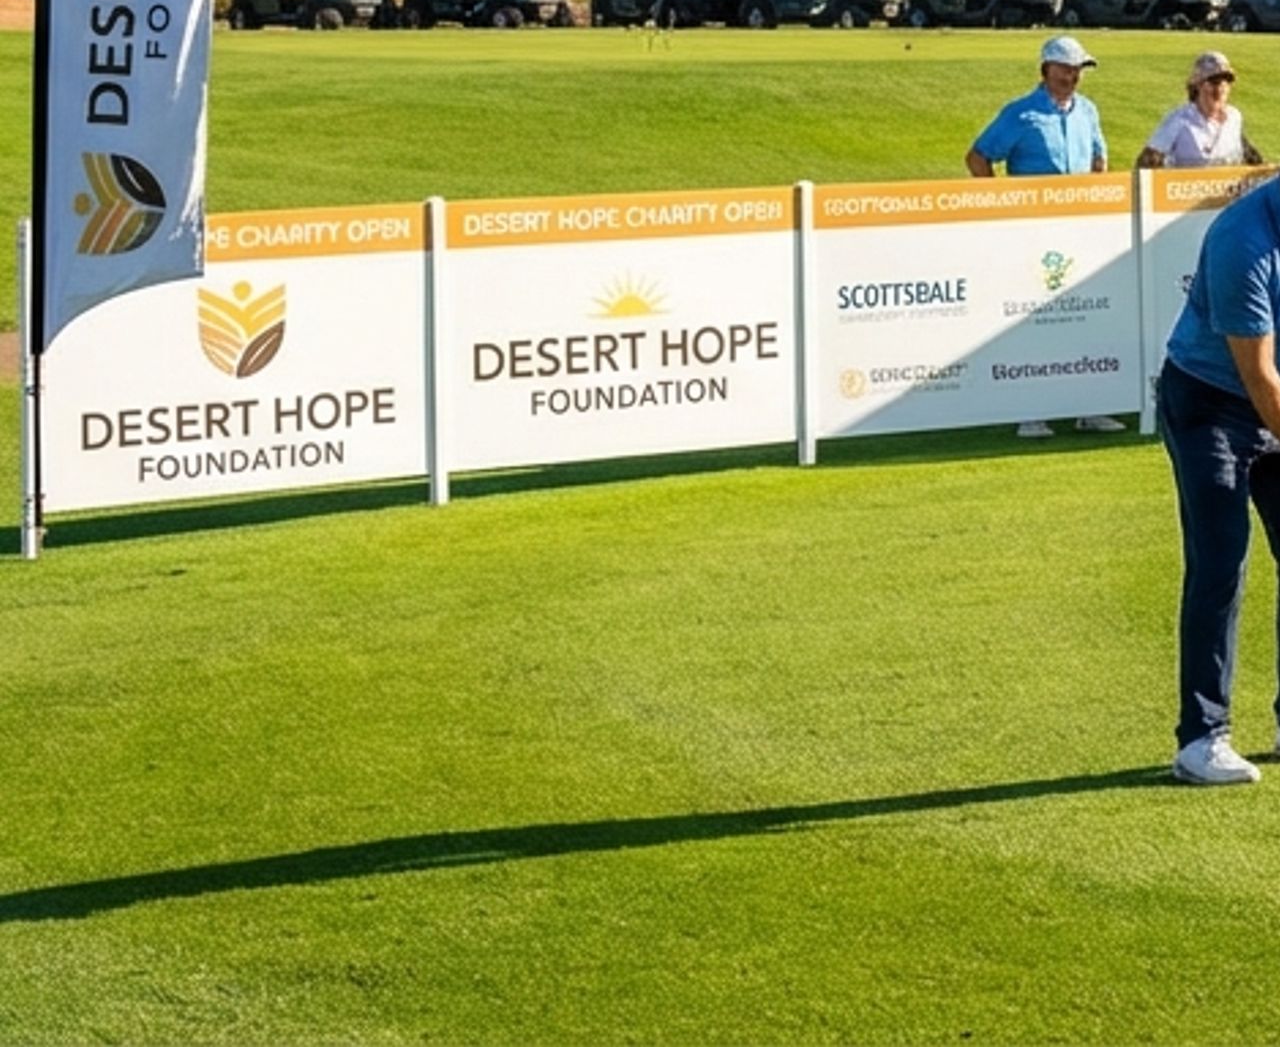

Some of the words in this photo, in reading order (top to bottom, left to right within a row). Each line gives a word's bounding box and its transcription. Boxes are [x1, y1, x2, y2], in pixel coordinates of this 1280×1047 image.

[463, 210, 552, 236] DESERT
[472, 331, 646, 382] DESERT
[661, 321, 779, 367] HOPE
[530, 376, 728, 416] FOUNDATION
[81, 399, 259, 451] DESERT
[274, 387, 397, 434] HOPE
[138, 440, 345, 482] FOUNDATION
